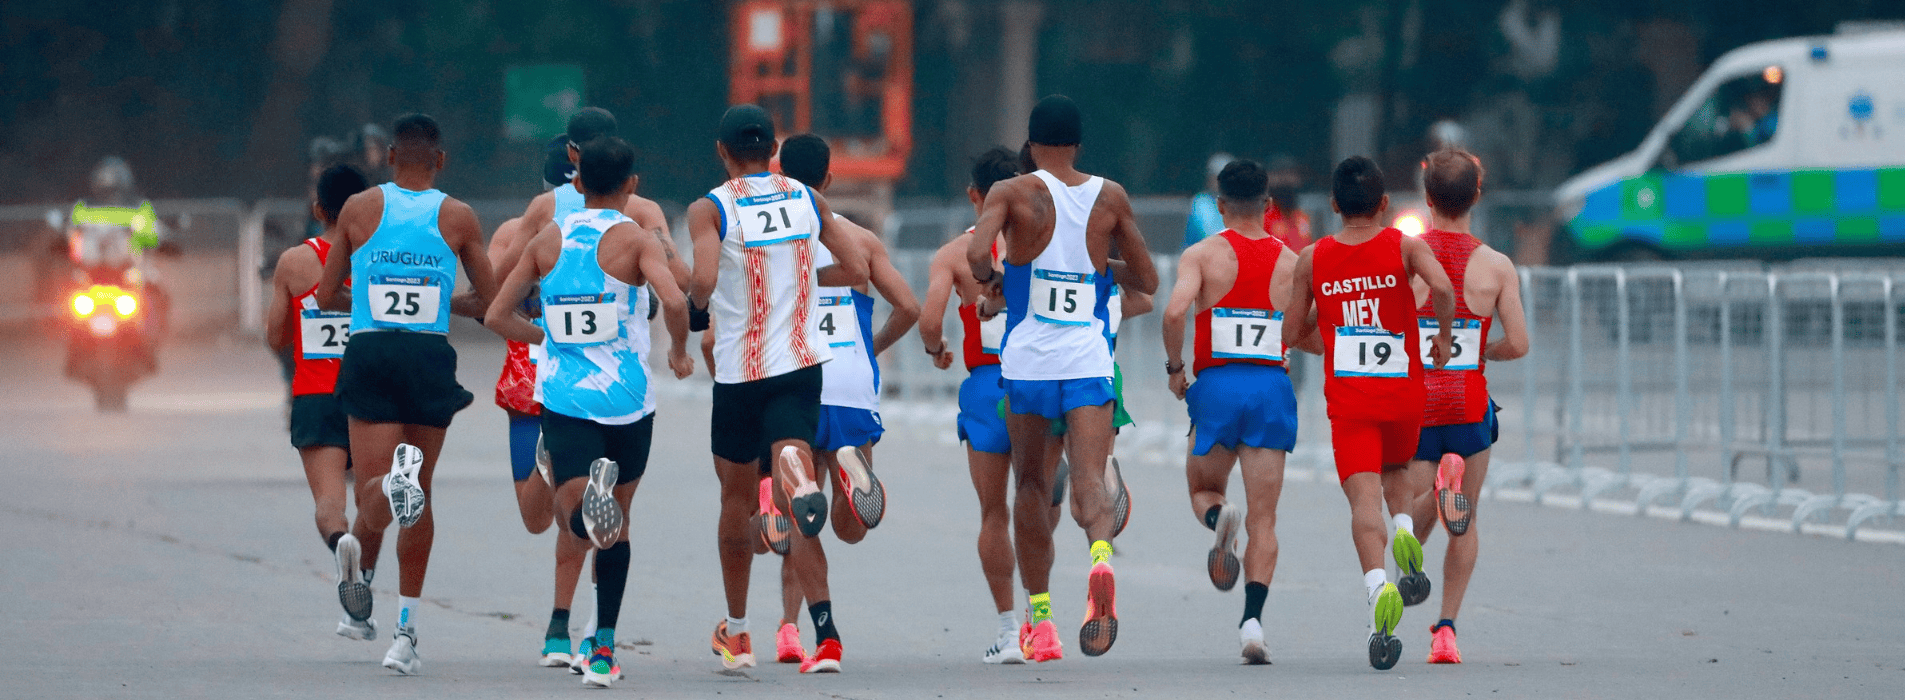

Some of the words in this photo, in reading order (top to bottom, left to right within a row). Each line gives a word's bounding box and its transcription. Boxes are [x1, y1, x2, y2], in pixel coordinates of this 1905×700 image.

[757, 206, 792, 234] 21
[370, 251, 443, 267] URUGUAY
[1321, 274, 1397, 297] CASTILLO
[384, 291, 420, 316] 25
[1048, 288, 1077, 313] 15
[1341, 292, 1383, 329] MÉX
[320, 323, 350, 348] 23
[564, 310, 598, 336] 13
[819, 312, 836, 335] 4
[1235, 323, 1267, 347] 17
[1358, 341, 1392, 366] 19
